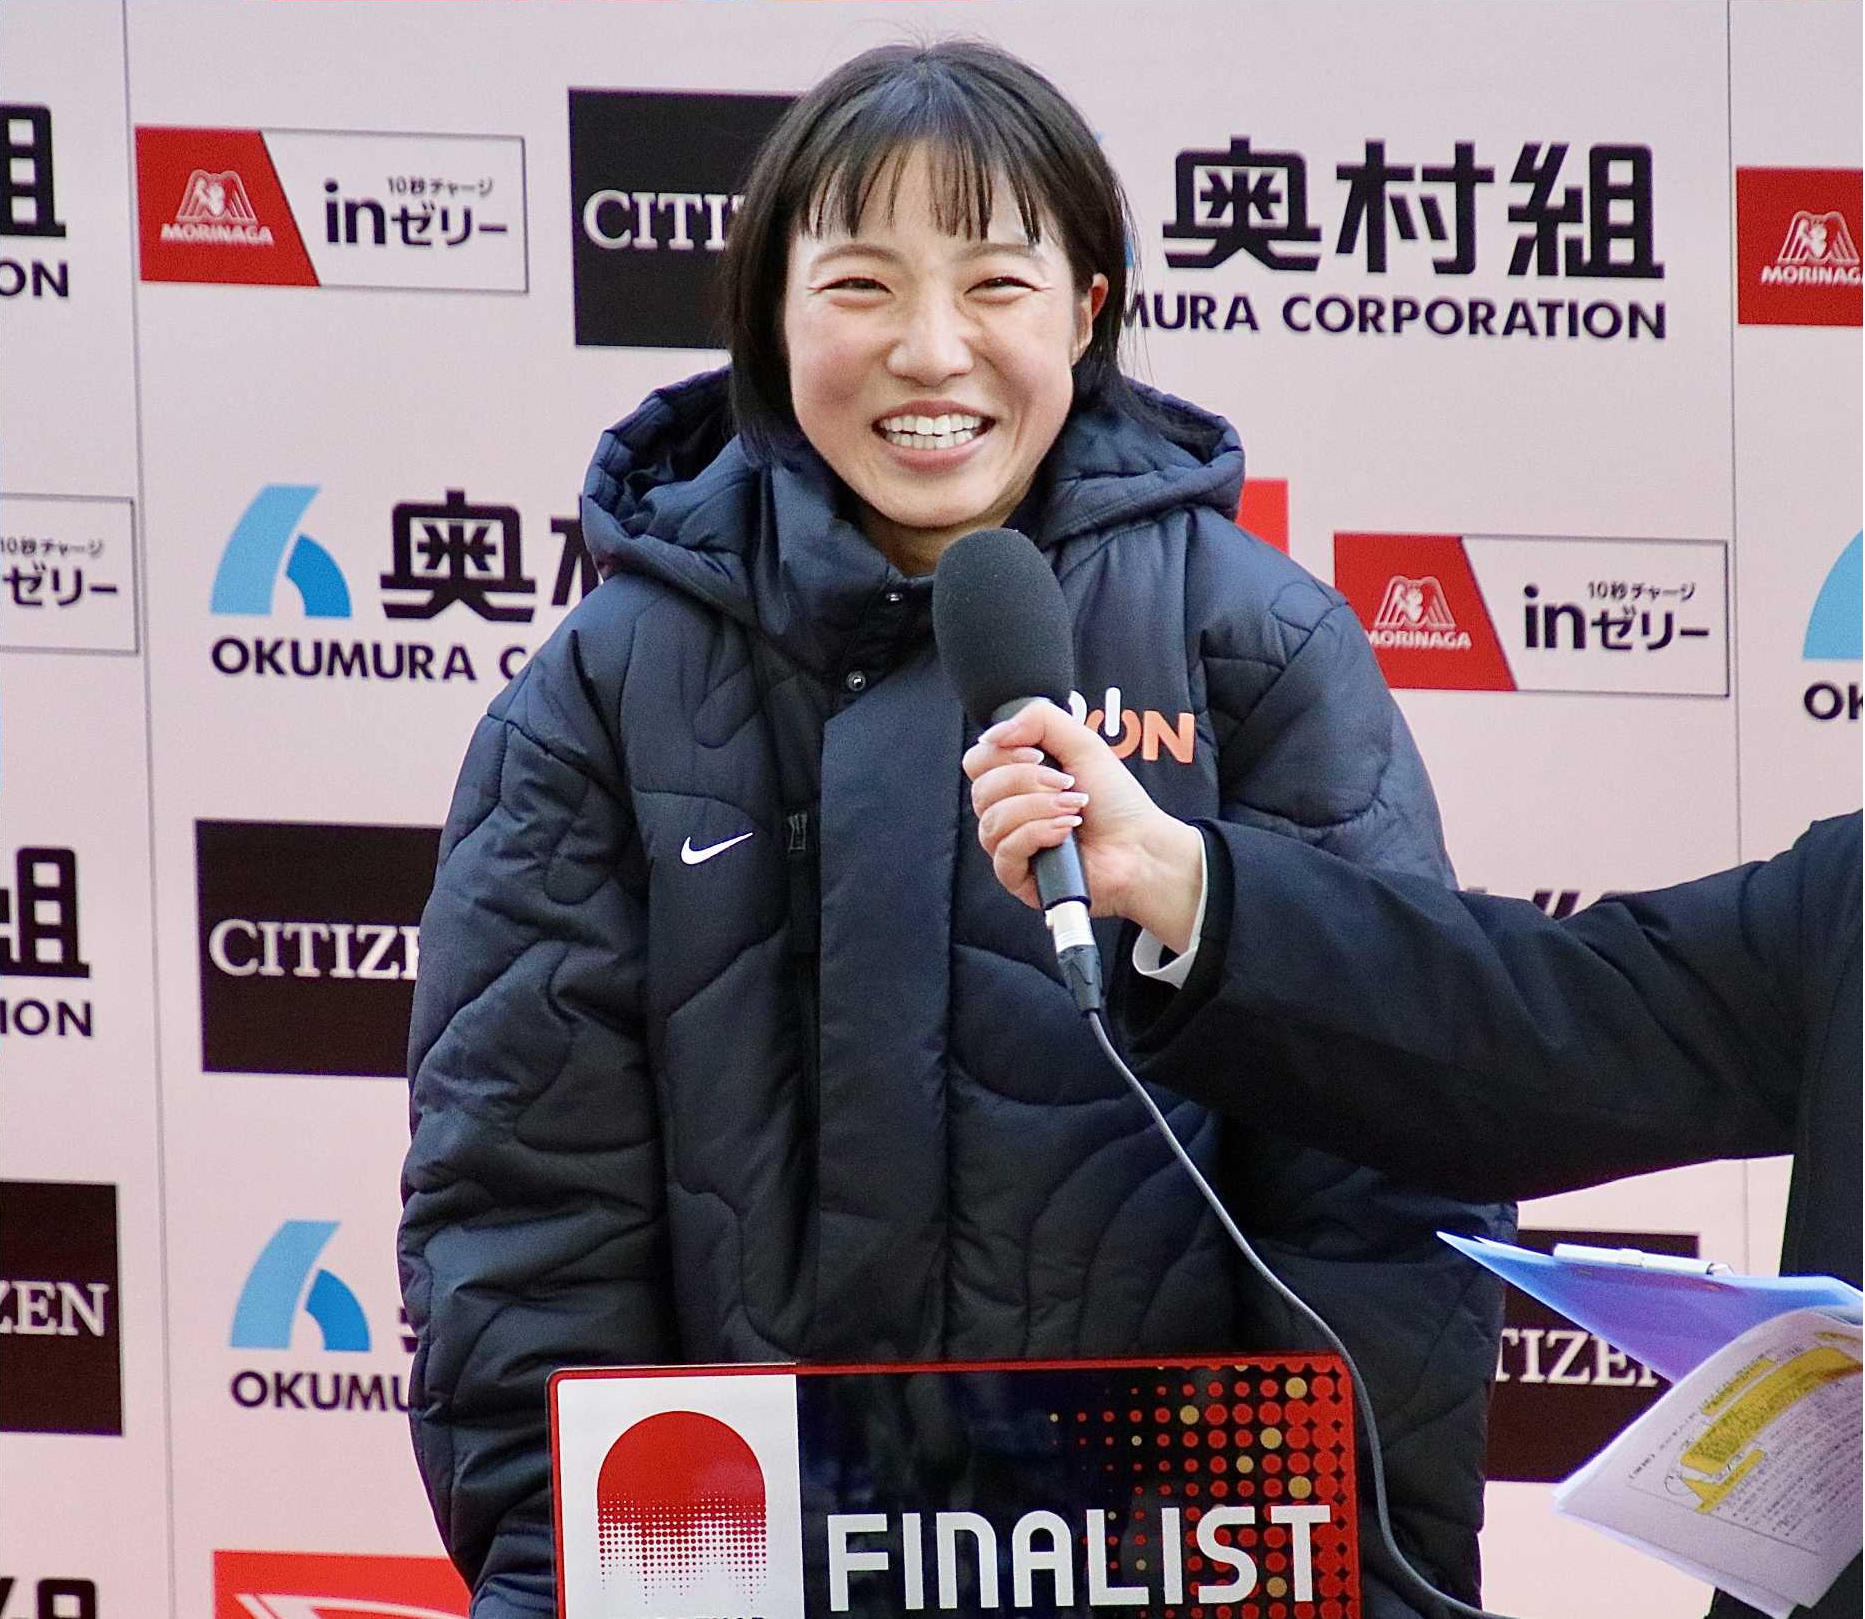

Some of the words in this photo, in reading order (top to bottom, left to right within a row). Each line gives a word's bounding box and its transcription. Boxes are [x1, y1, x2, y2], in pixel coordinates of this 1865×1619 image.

[583, 189, 746, 251] CITI
[1162, 134, 1666, 280] 奥村組
[160, 222, 274, 246] MORINAGA
[1761, 266, 1864, 285] MORINAG
[1281, 294, 1666, 340] CORPORATION
[2, 562, 118, 607] ゼリー
[211, 636, 477, 682] OKUMURA
[826, 1504, 1332, 1612] FINALIST
